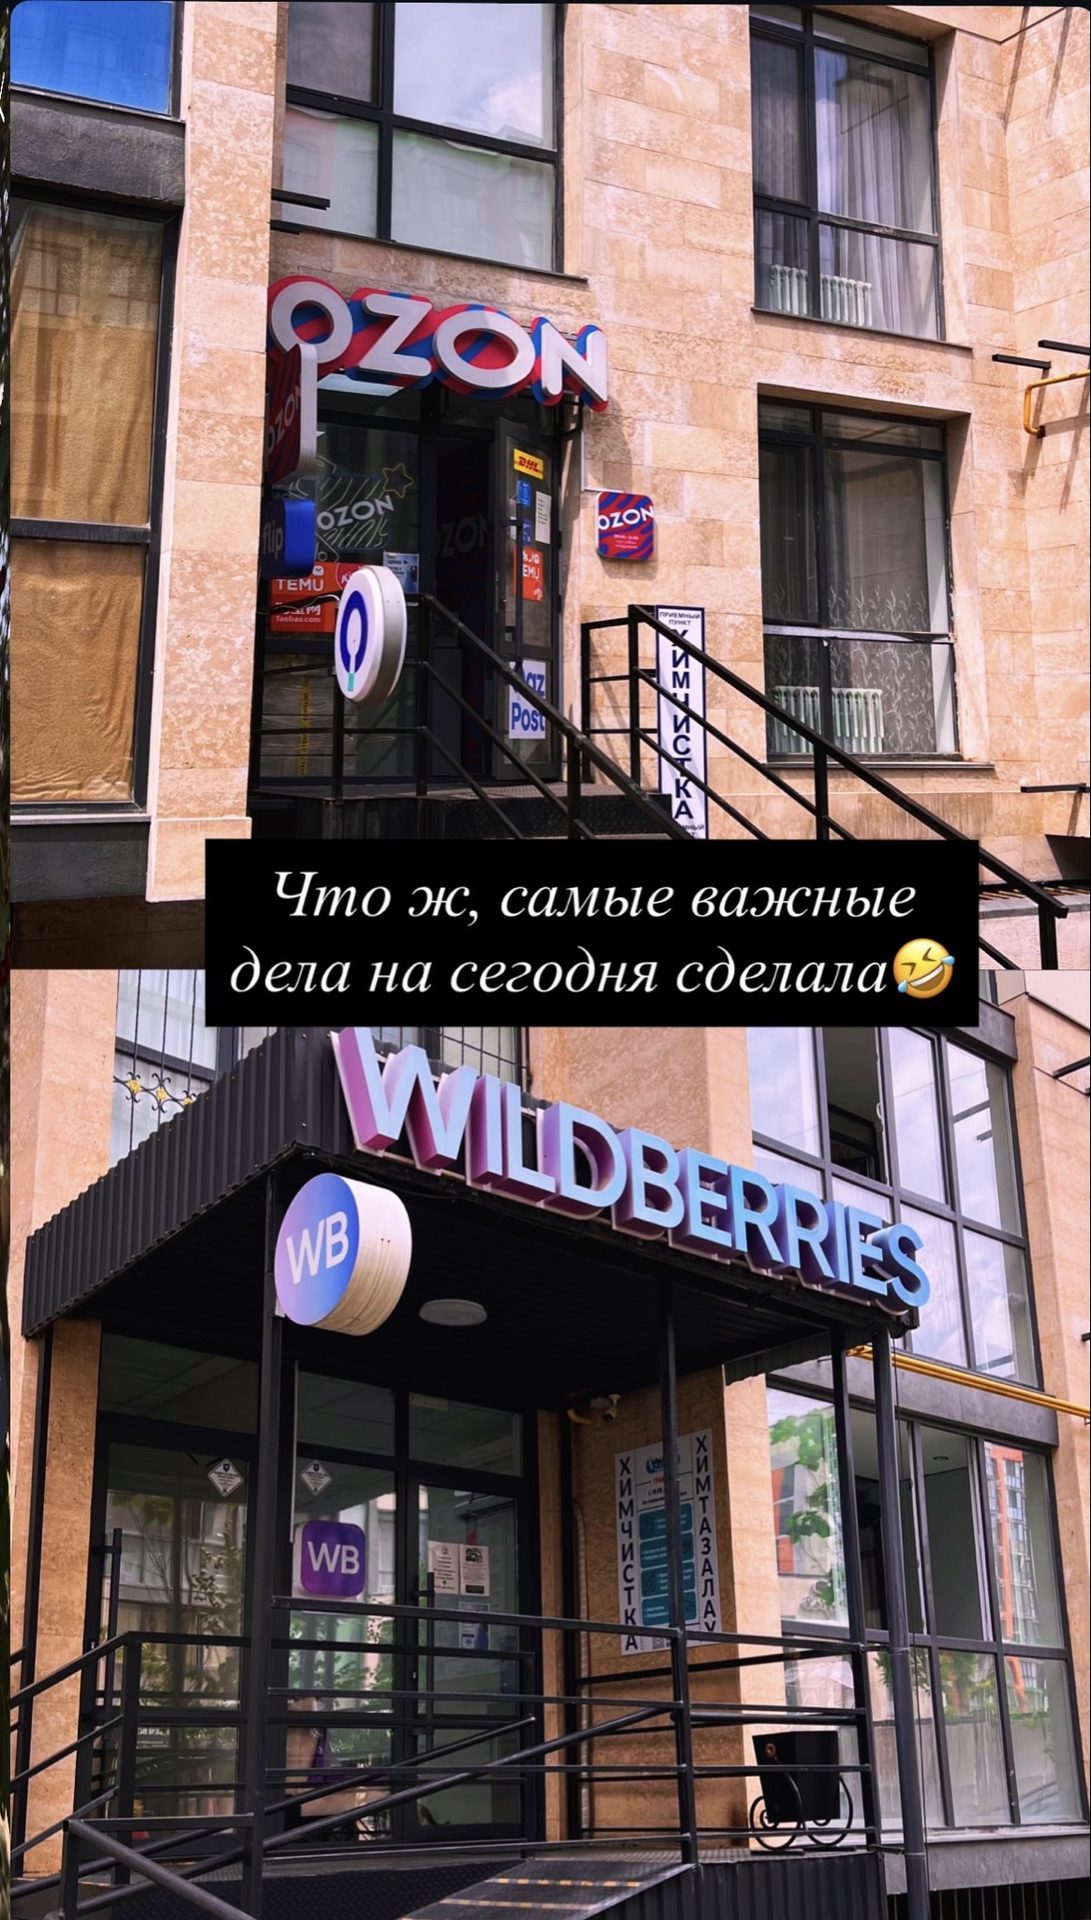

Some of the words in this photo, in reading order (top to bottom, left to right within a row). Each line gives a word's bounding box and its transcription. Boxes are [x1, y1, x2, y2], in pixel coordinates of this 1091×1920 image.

[270, 280, 609, 402] OZON
[518, 455, 540, 473] DHL
[317, 495, 395, 531] OZON
[598, 505, 655, 531] OZON
[262, 520, 284, 560] flip
[276, 578, 325, 592] TEMU
[523, 563, 540, 580] EMU
[276, 614, 321, 624] Taobao.com
[660, 611, 701, 620] ПРИЕМНЫЙ
[336, 1026, 931, 1310] WILDBERRIES
[286, 1211, 349, 1285] WB
[307, 1541, 360, 1575] WB
[619, 1456, 638, 1651] ХИМЧИСТКА
